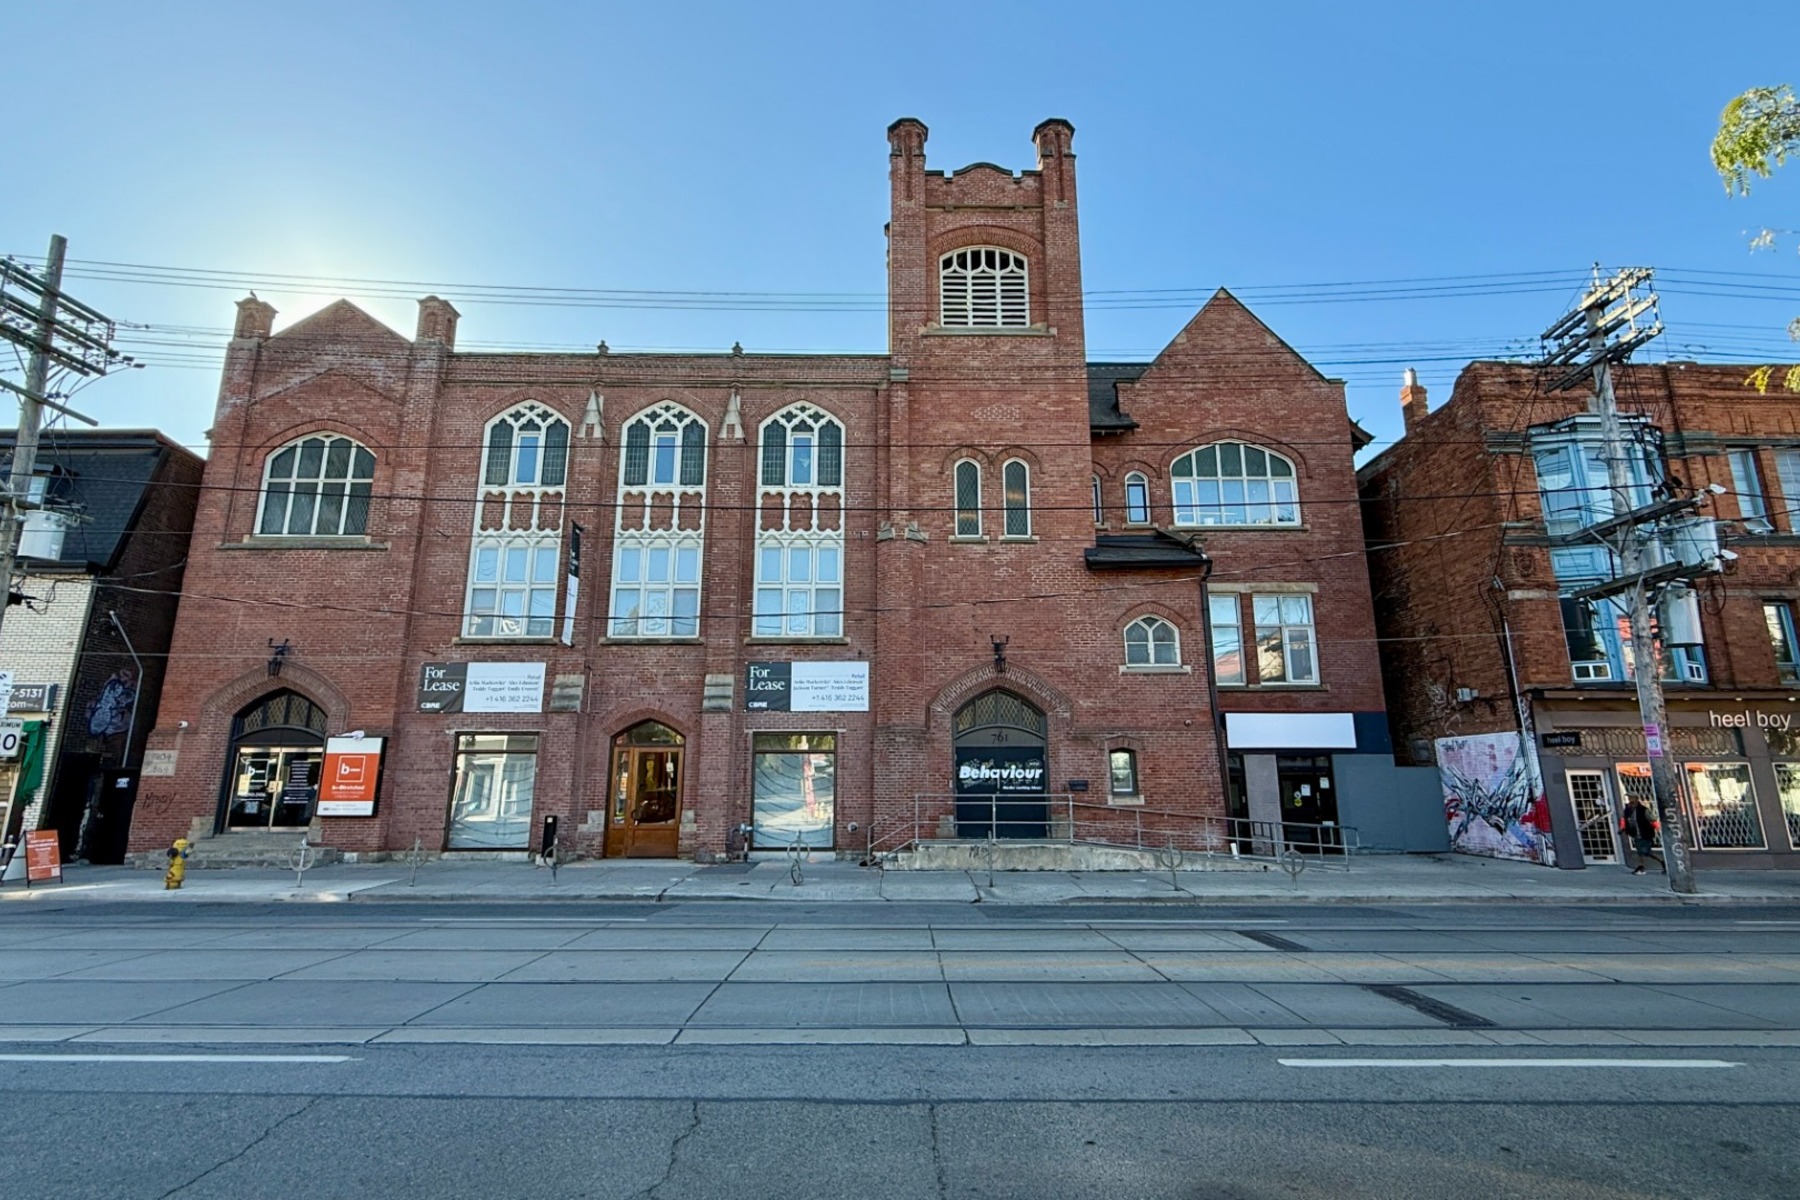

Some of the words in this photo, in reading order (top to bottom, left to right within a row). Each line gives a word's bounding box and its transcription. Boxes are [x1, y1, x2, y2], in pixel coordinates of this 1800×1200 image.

[425, 666, 446, 678] For
[749, 666, 770, 678] For
[423, 680, 460, 691] Lease
[749, 679, 785, 691] Lease
[1709, 710, 1751, 727] heel
[1756, 710, 1791, 731] boy
[991, 731, 1008, 744] 761
[959, 765, 1043, 779] Behaviour
